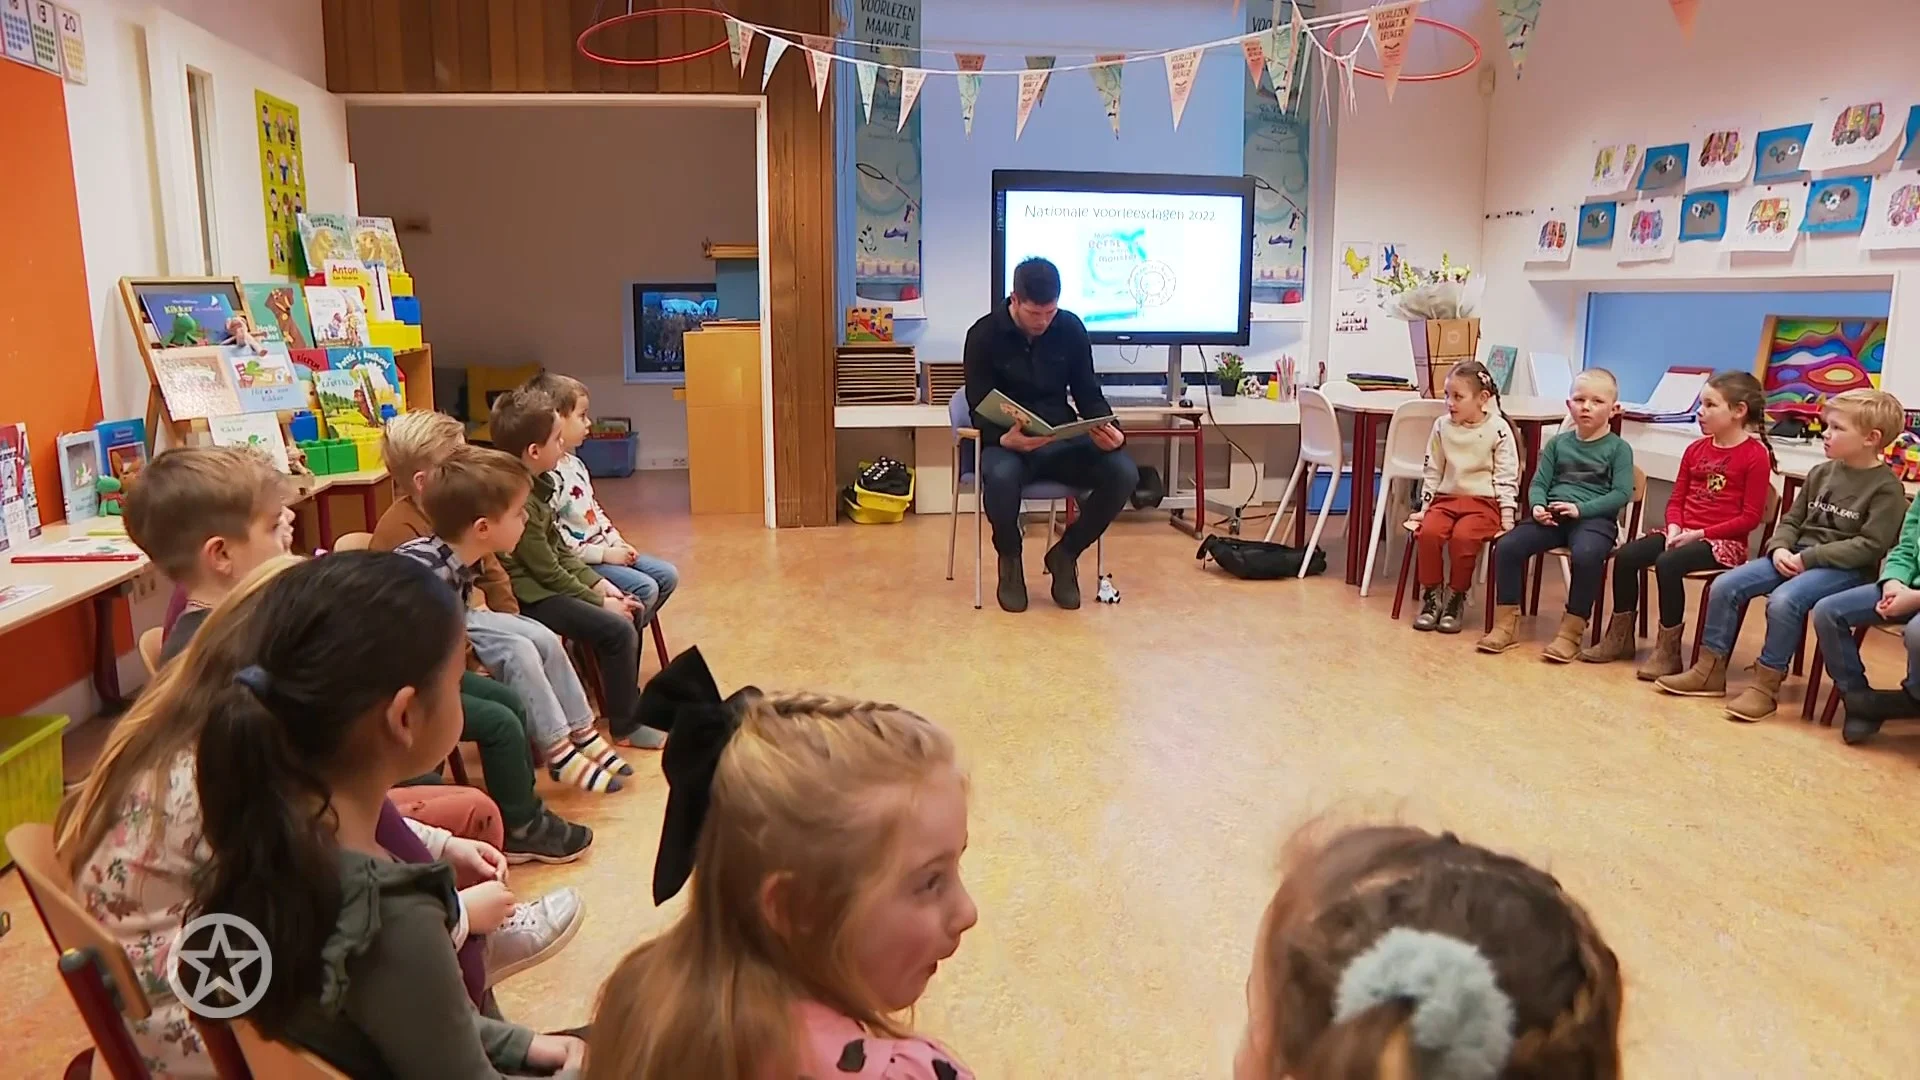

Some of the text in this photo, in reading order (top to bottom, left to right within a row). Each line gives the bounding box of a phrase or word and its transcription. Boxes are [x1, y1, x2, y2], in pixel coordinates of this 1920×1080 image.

[861, 0, 916, 22] VOORLEZEN
[63, 13, 76, 32] 20
[865, 16, 912, 41] MAAKT JE
[1024, 204, 1089, 218] Nationale
[1188, 210, 1216, 221] 2022
[332, 264, 358, 274] Anton
[164, 305, 193, 315] Kikker
